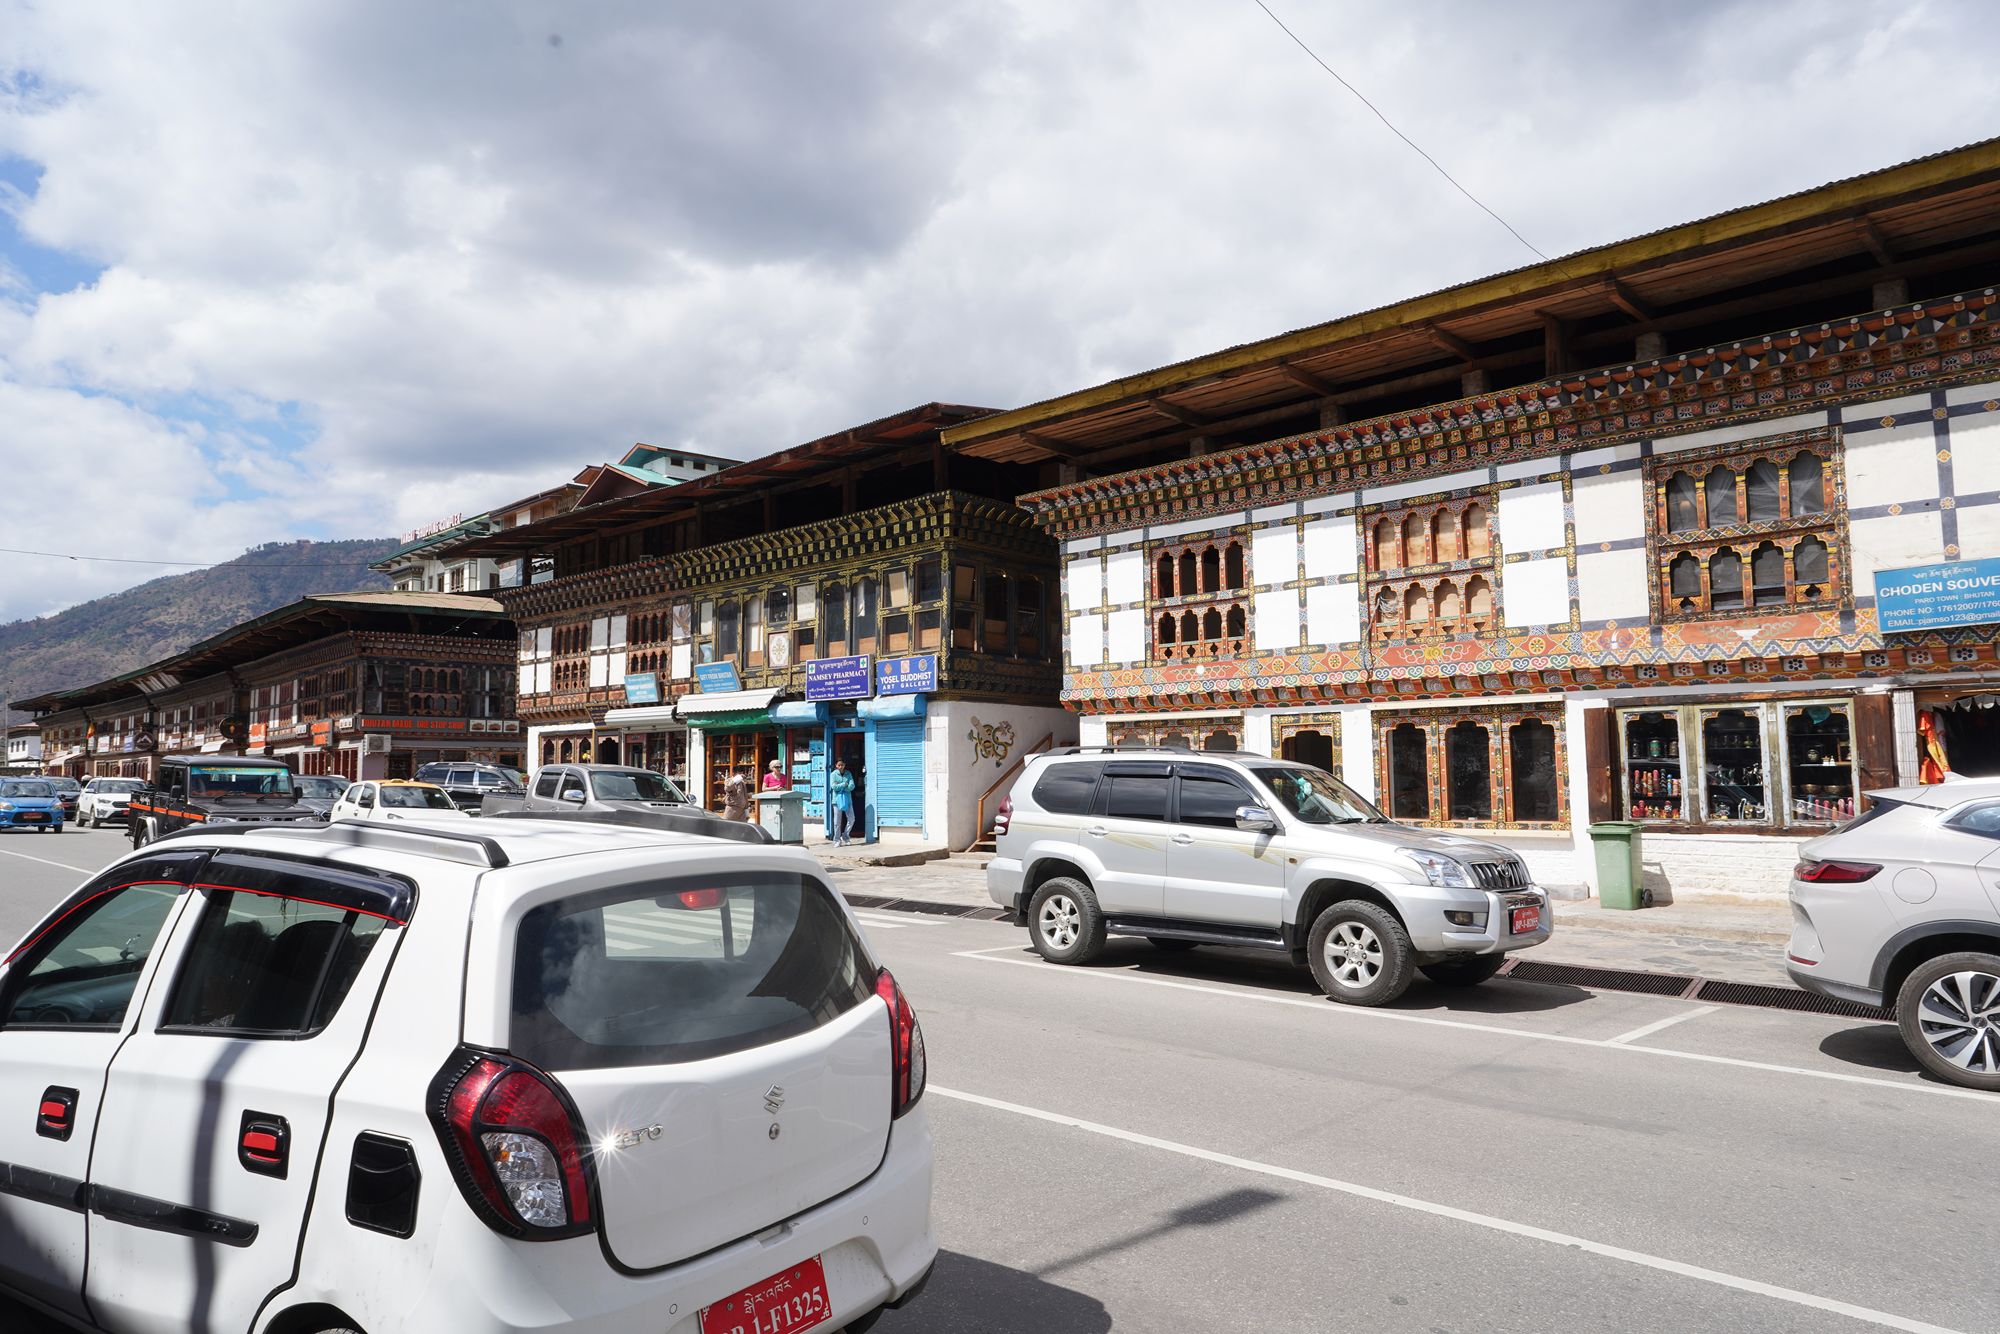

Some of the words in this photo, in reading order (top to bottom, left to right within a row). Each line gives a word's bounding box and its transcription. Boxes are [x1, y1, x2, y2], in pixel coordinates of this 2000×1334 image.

[1879, 581, 1943, 598] CHODEN
[1947, 575, 2000, 590] SOUVE
[1914, 596, 1935, 604] PARO
[1936, 594, 1959, 602] TOWN
[1963, 590, 1995, 599] BHUTAN
[1883, 608, 1915, 617] PHONE
[808, 673, 833, 681] NAMSEY
[833, 669, 867, 679] PHARMACY
[880, 675, 900, 684] YOSEL
[900, 671, 932, 682] BUDDHIST
[900, 680, 931, 689] GALLERY
